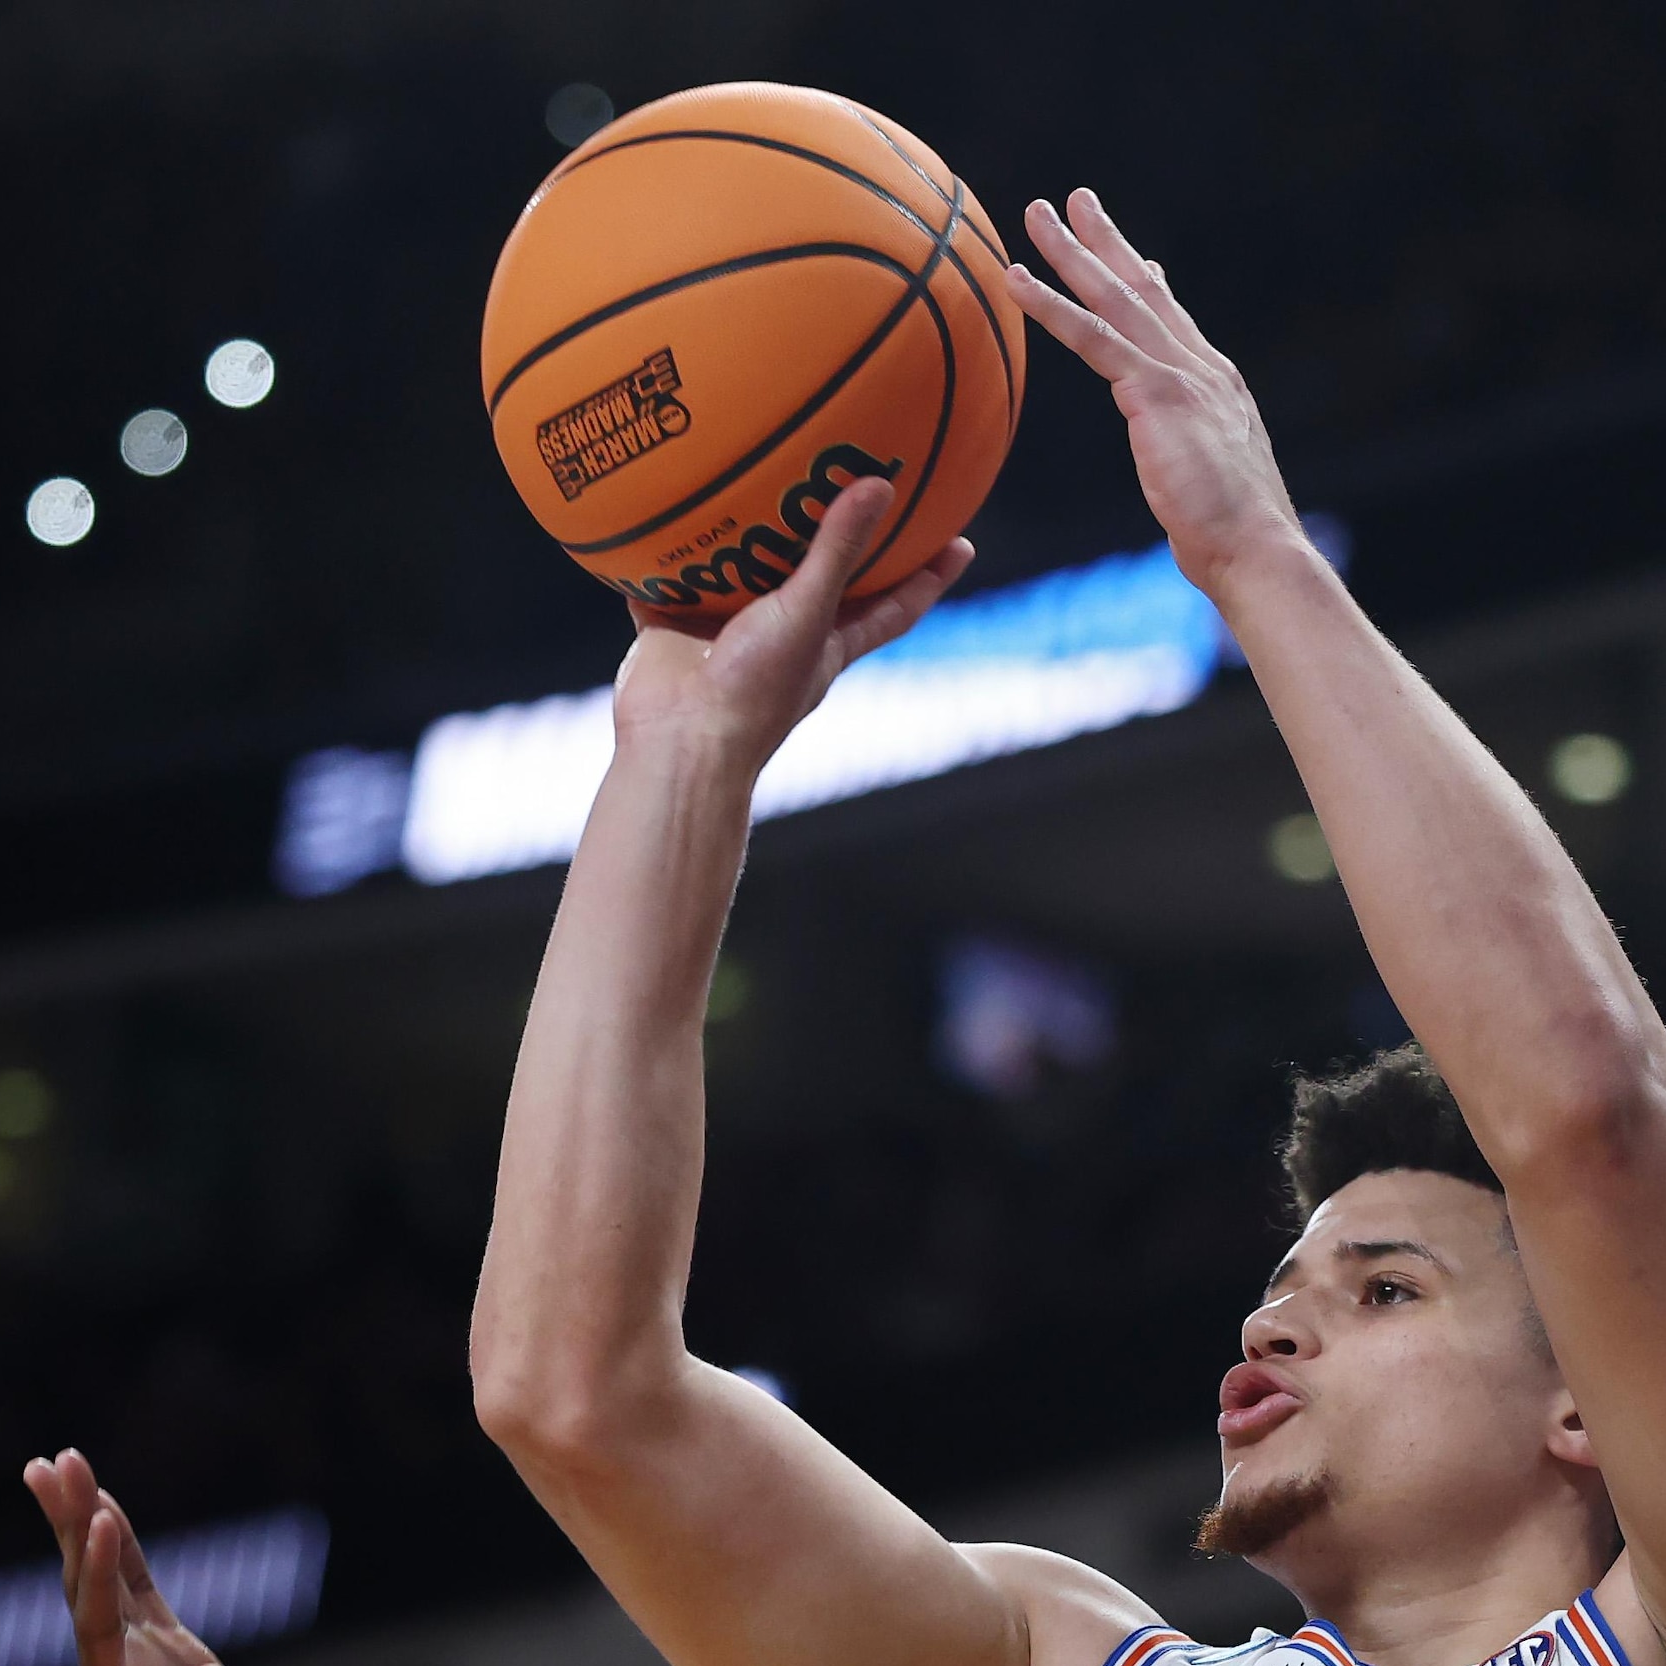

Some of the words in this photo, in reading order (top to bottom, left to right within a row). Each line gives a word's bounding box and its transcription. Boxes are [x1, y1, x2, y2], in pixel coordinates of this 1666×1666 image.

[538, 390, 636, 466] MADNESS
[580, 413, 663, 478] MARCH
[695, 515, 738, 548] EVO
